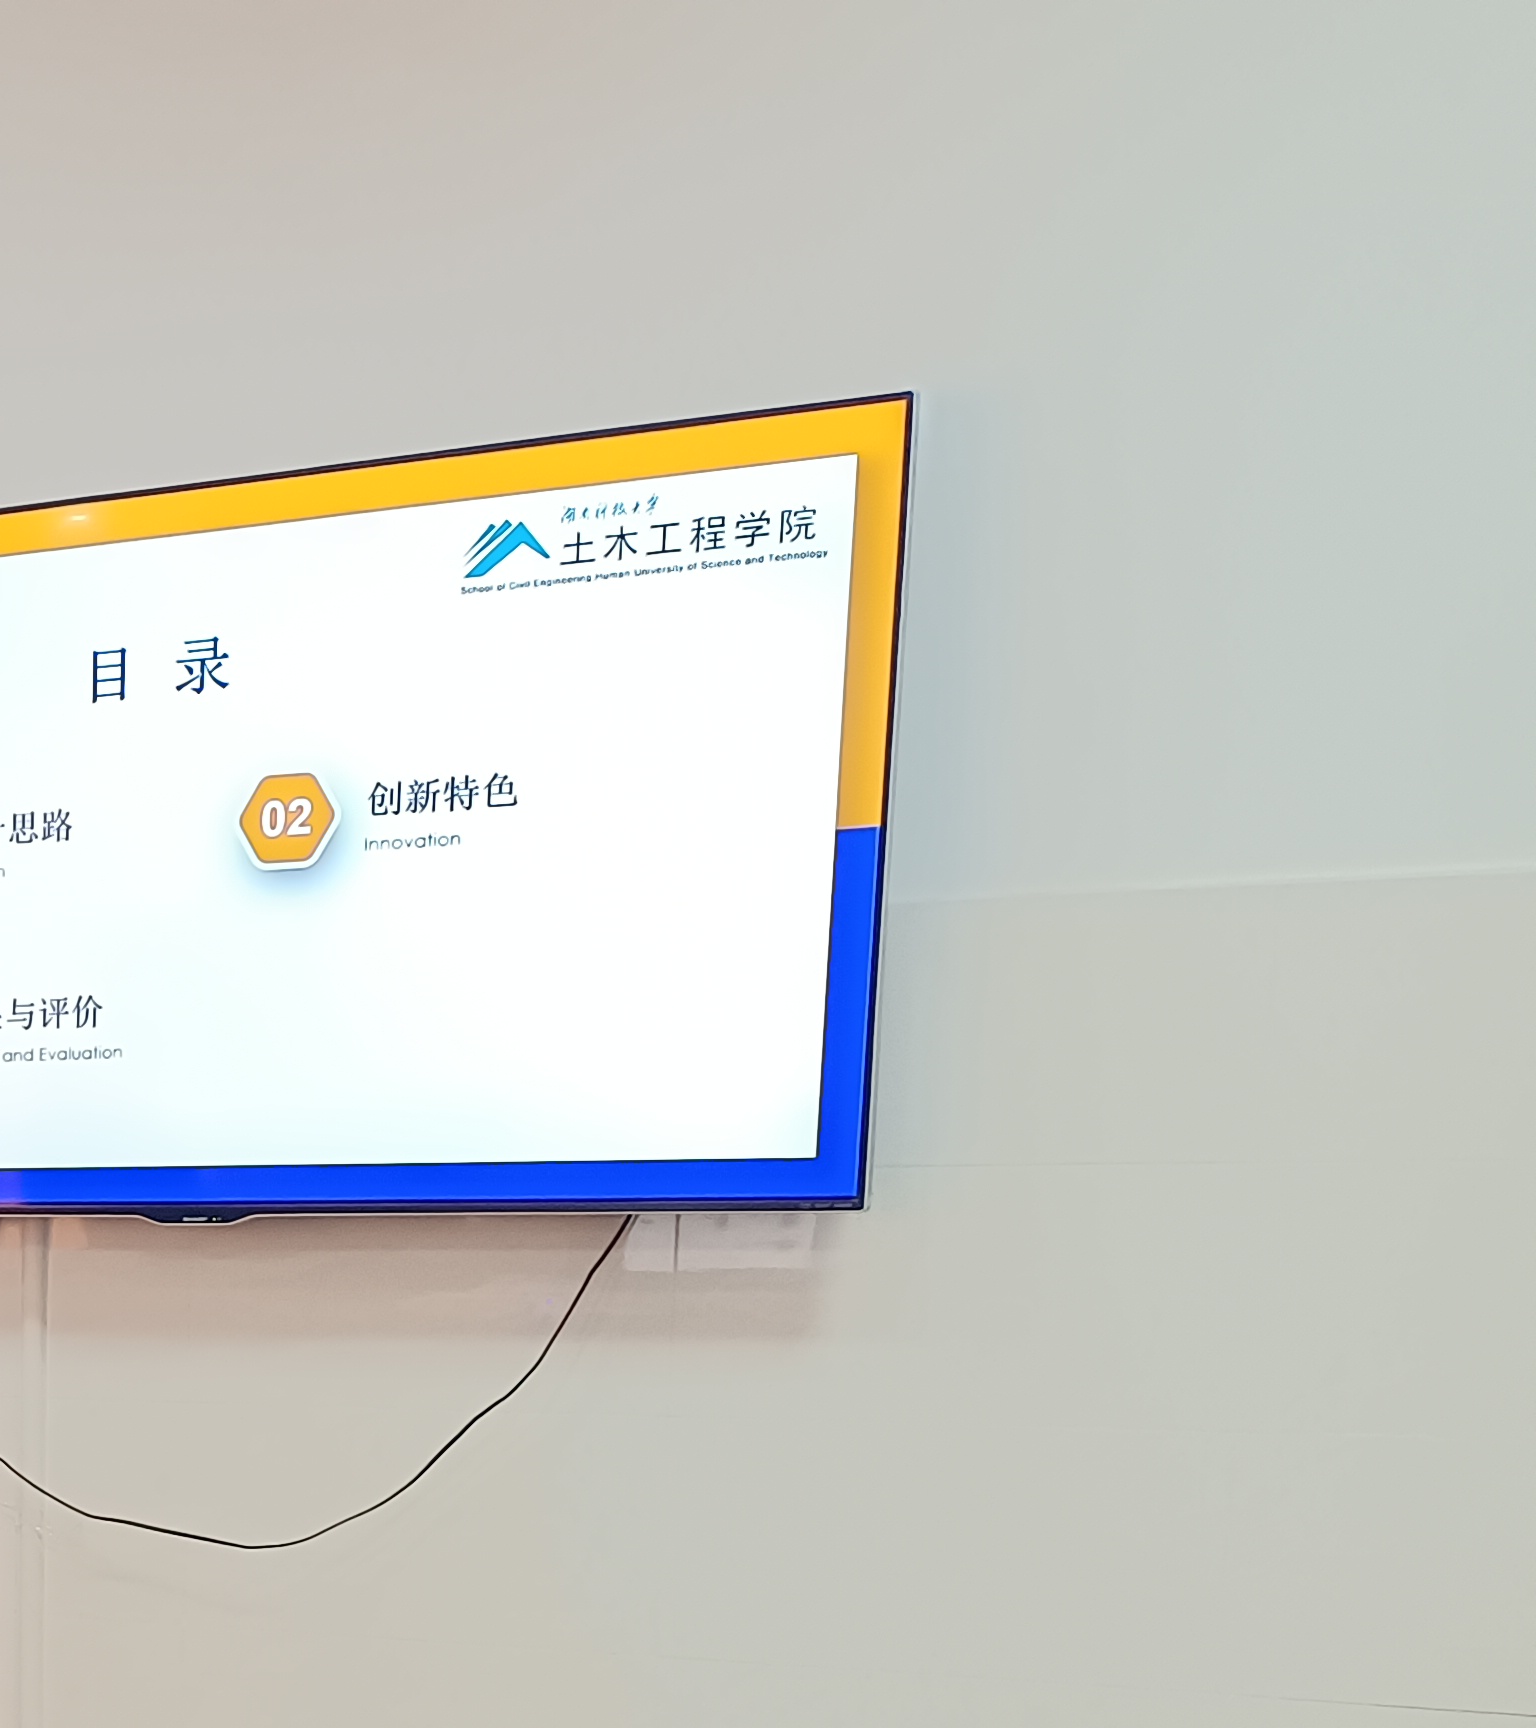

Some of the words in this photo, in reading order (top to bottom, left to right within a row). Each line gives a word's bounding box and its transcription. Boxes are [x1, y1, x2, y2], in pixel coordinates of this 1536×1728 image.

[559, 505, 817, 565] 土木工程学院
[461, 585, 493, 594] School
[497, 583, 505, 591] of
[634, 564, 683, 576] University
[687, 562, 697, 571] of
[701, 558, 742, 570] Science
[745, 555, 765, 566] and
[769, 550, 828, 562] Technology
[367, 772, 518, 817] 创新特色
[259, 797, 313, 838] 02
[363, 832, 462, 852] Innovation
[2, 1047, 34, 1063] and
[39, 1045, 123, 1062] Evaluation
